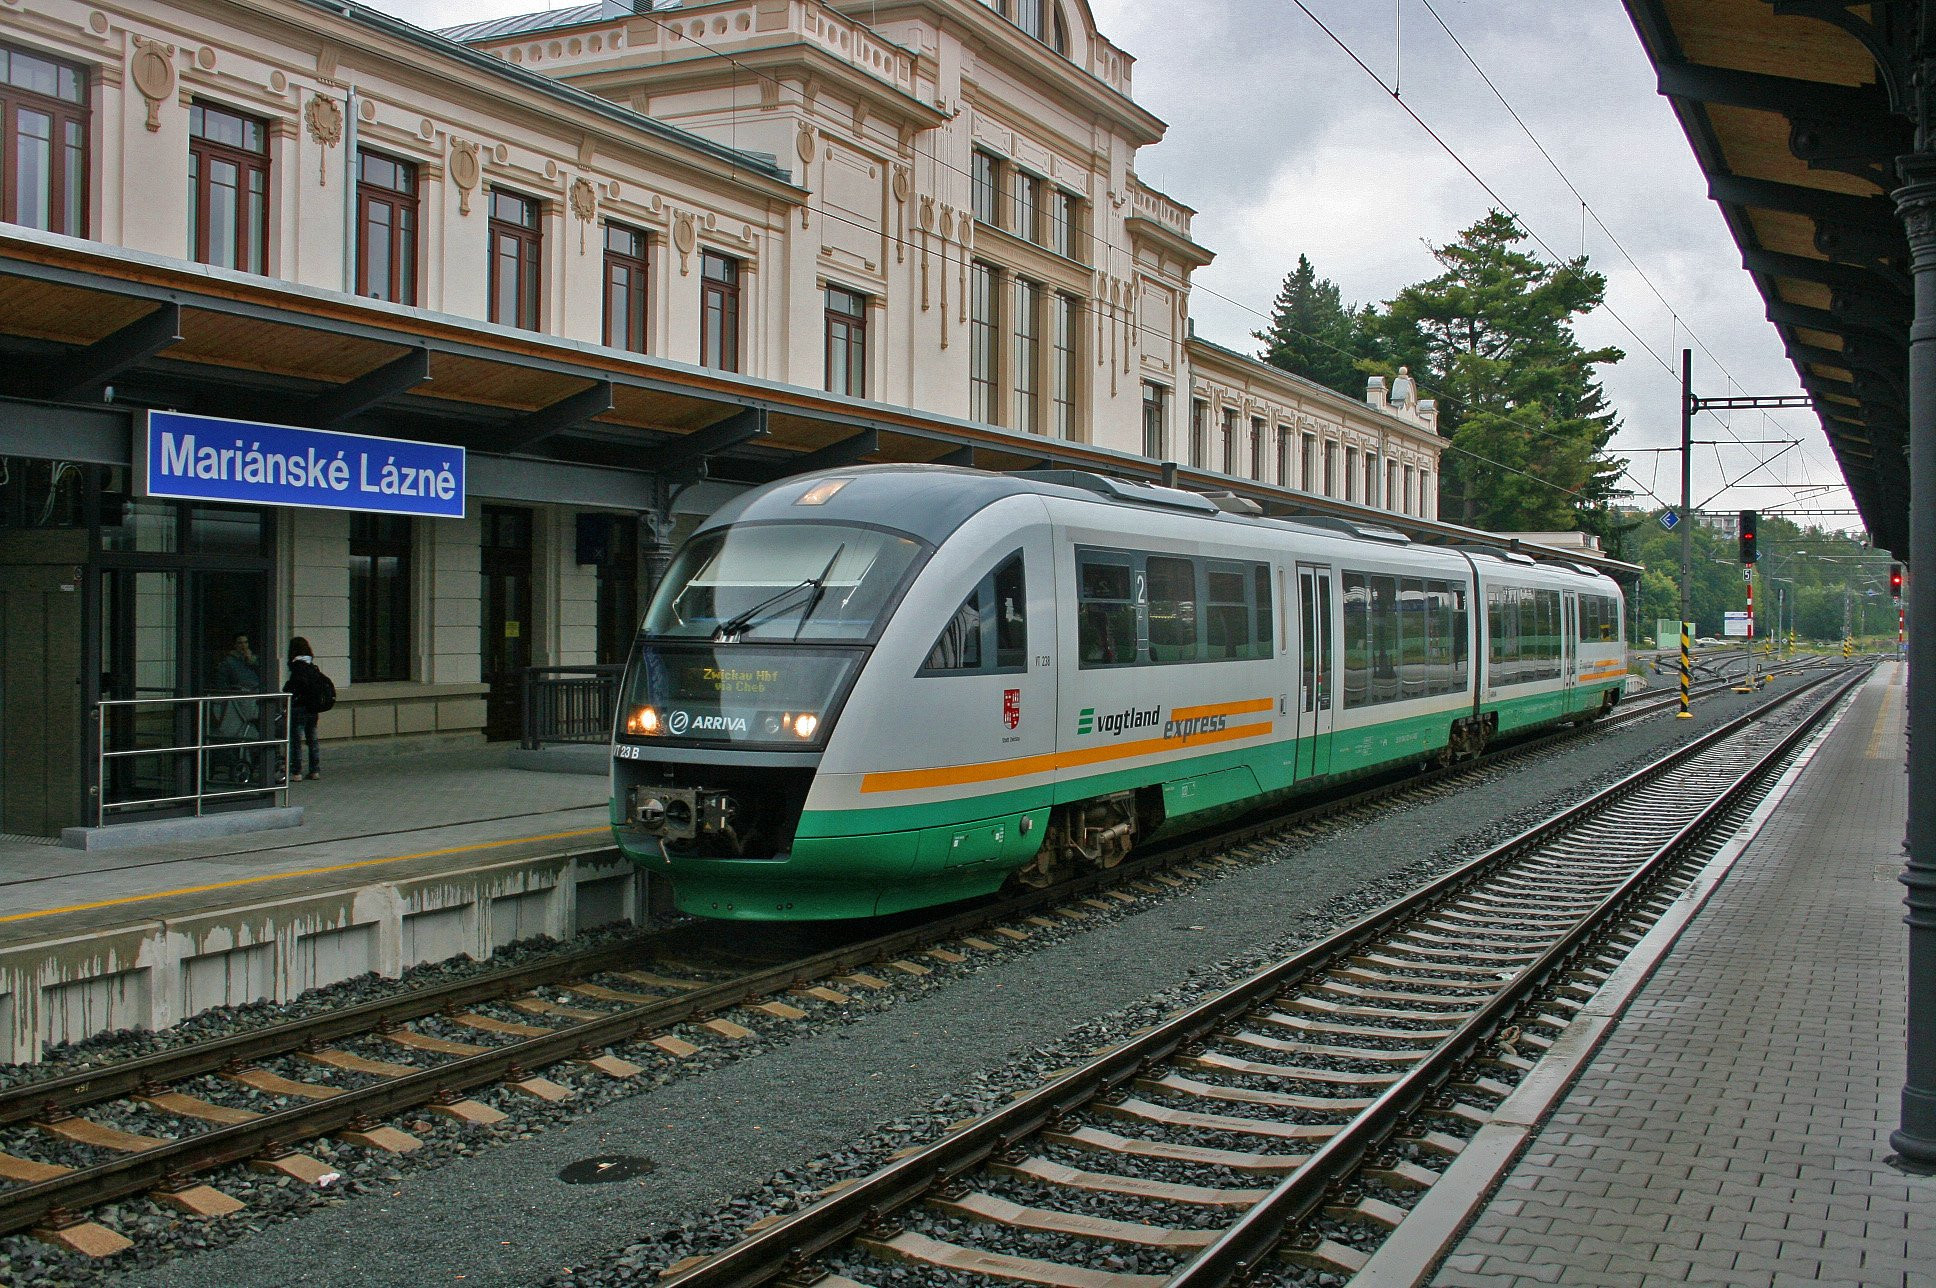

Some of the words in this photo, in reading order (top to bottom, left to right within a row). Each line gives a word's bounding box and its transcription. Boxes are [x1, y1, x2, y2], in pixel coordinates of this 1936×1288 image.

[161, 432, 350, 491] Mariánské
[360, 453, 456, 500] Lázně
[1136, 575, 1145, 604] 2
[703, 668, 753, 681] Zwickau
[756, 670, 779, 682] Hbf
[735, 681, 766, 693] Cheb
[691, 715, 747, 732] ARRIVA
[1097, 704, 1161, 736] vogtland
[1163, 713, 1227, 743] express
[620, 745, 631, 759] 23
[631, 747, 640, 760] B
